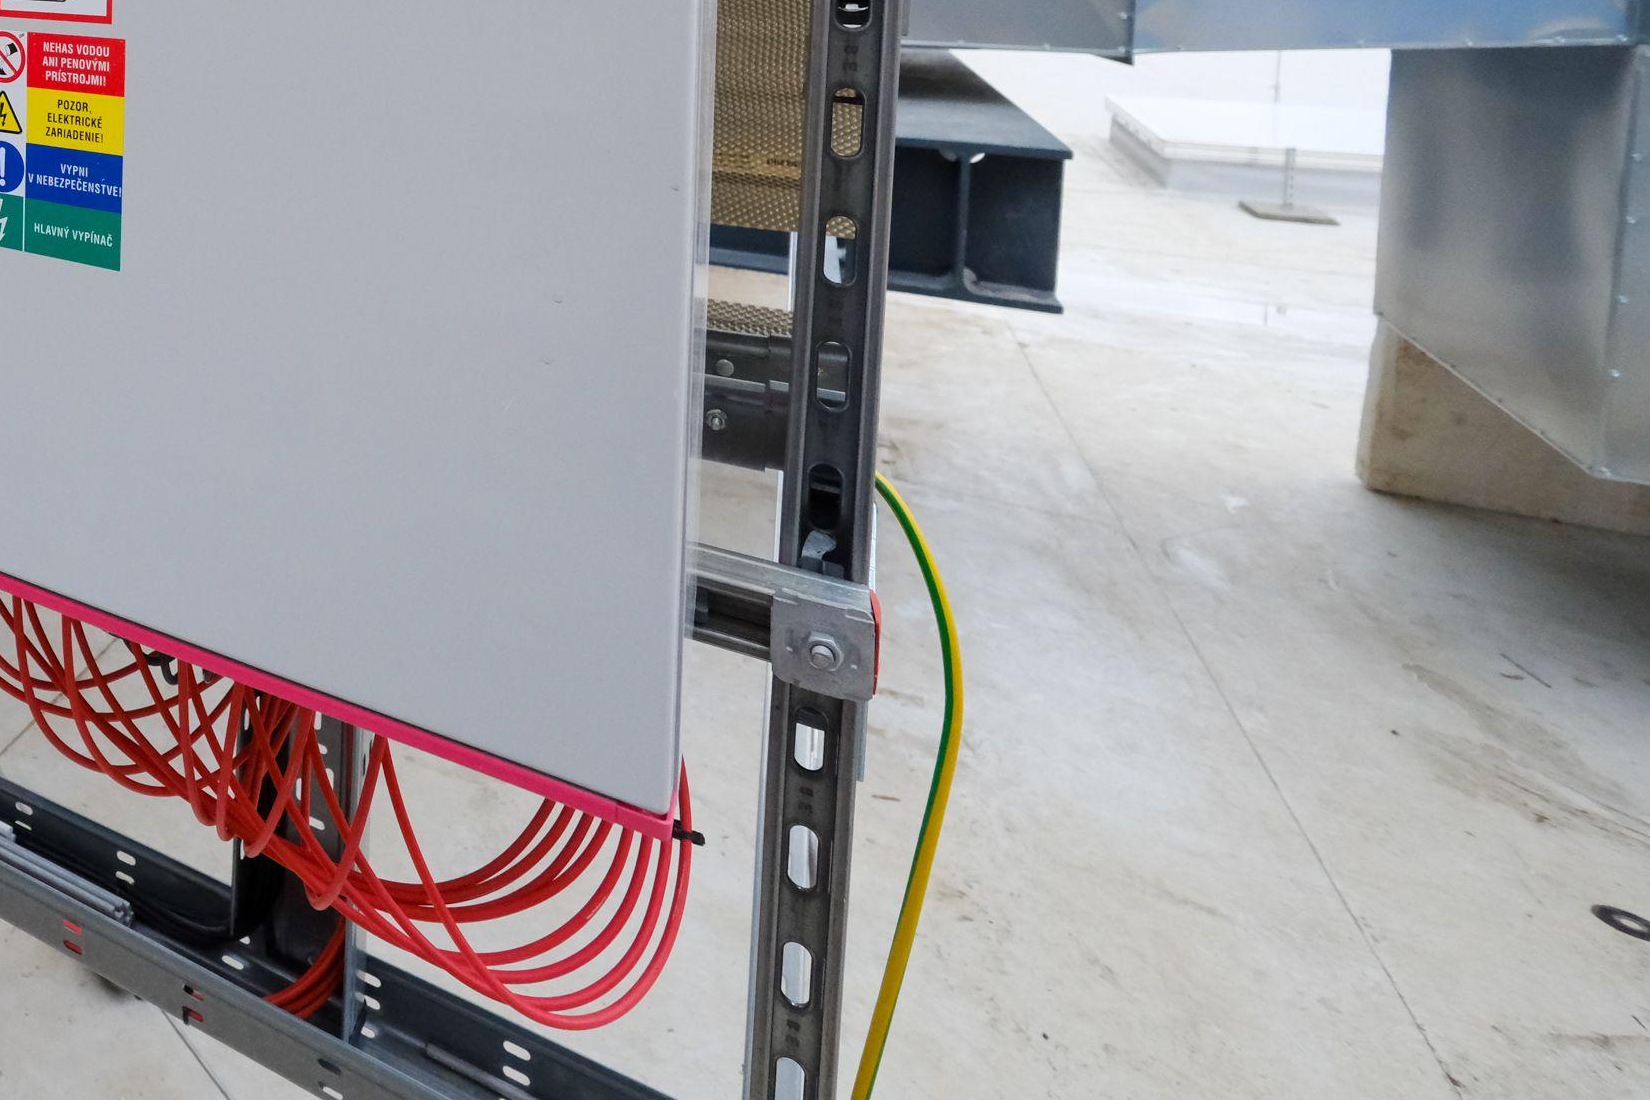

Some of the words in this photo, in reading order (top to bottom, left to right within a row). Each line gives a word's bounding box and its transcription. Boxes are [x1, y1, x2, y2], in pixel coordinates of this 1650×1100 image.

[43, 41, 74, 54] NEHAS
[76, 44, 110, 57] VODOU
[42, 56, 58, 68] ANI
[61, 57, 110, 72] PENOVÝMI
[45, 70, 106, 87] PRÍSTROJMI!
[47, 112, 103, 129] ELEKTRICKÉ
[45, 126, 104, 143] ZARIADENIE!
[28, 173, 34, 183] V
[60, 163, 89, 178] VYPNI
[33, 222, 70, 239] HLAVNÝ
[72, 228, 113, 248] VYPÍNAČ
